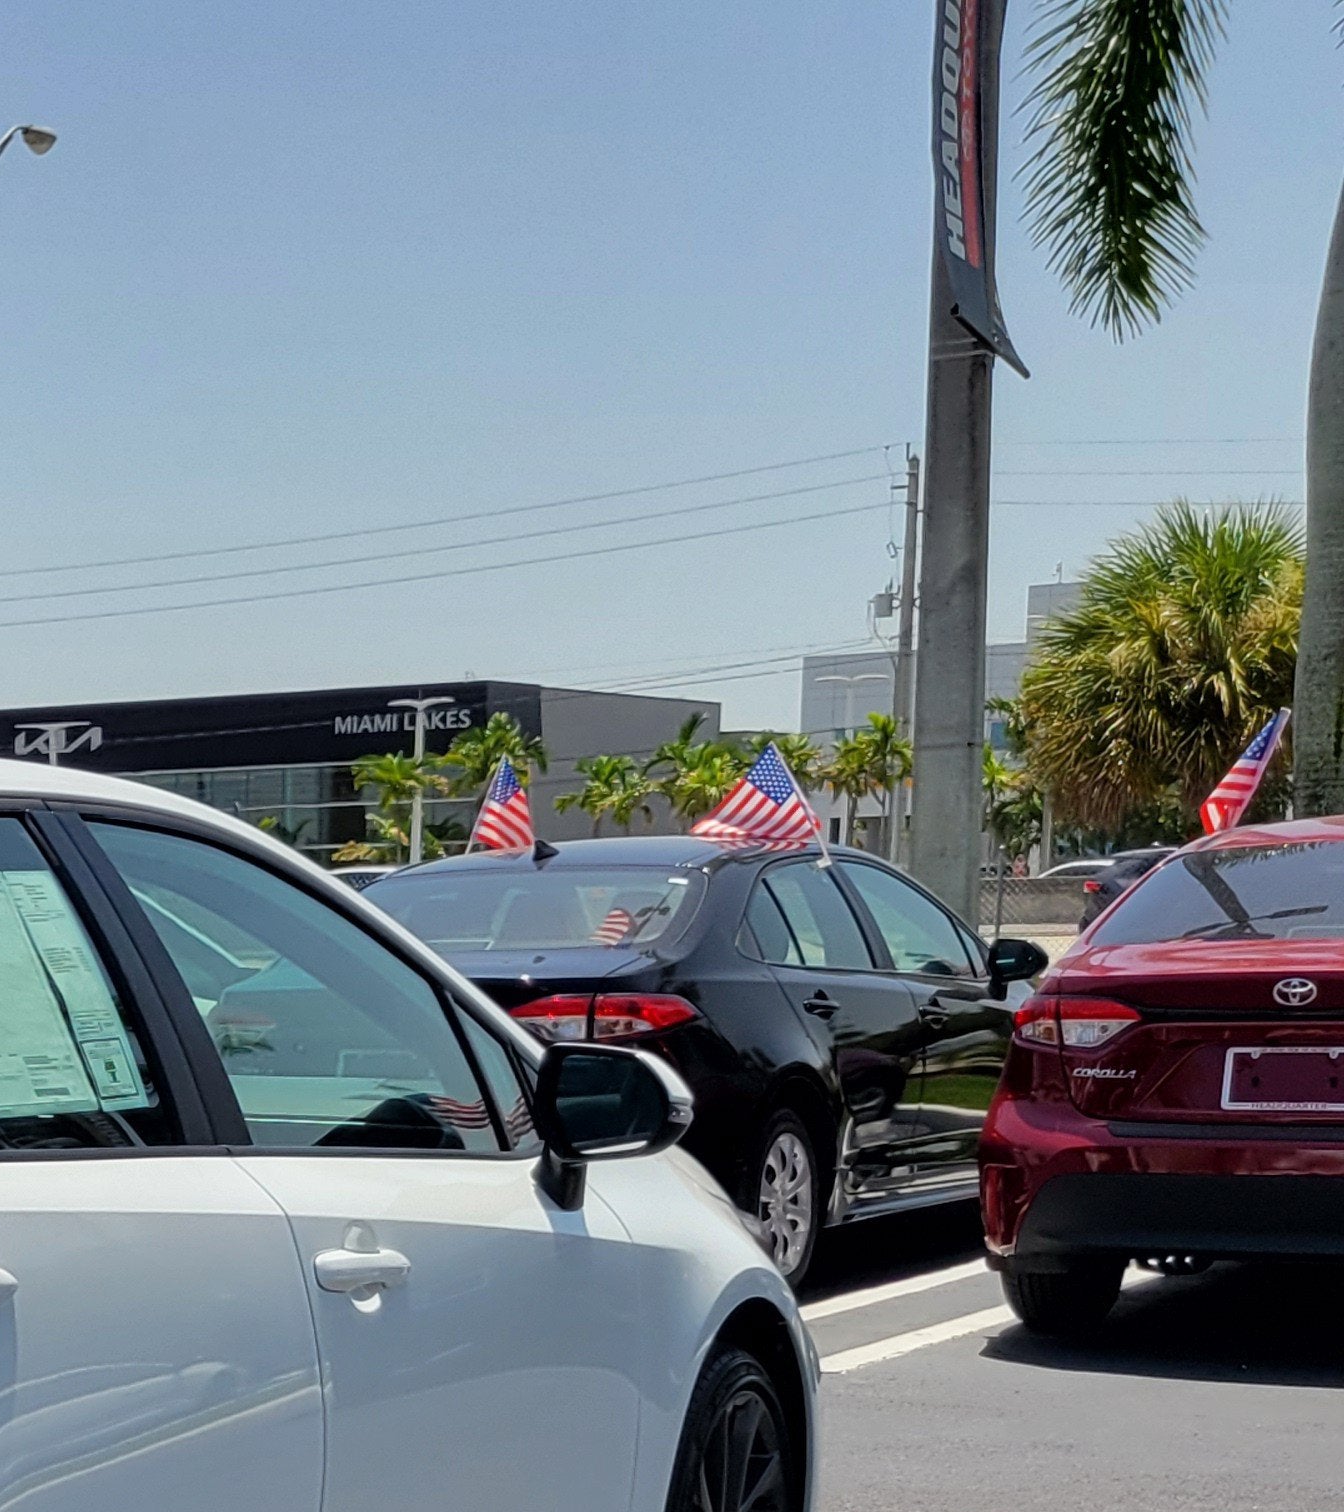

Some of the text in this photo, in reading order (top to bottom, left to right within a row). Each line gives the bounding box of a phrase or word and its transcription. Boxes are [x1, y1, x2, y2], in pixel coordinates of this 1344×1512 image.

[941, 0, 965, 260] HEADQU
[334, 709, 472, 735] MIAMI LAKES
[1072, 1067, 1137, 1079] COROLLA
